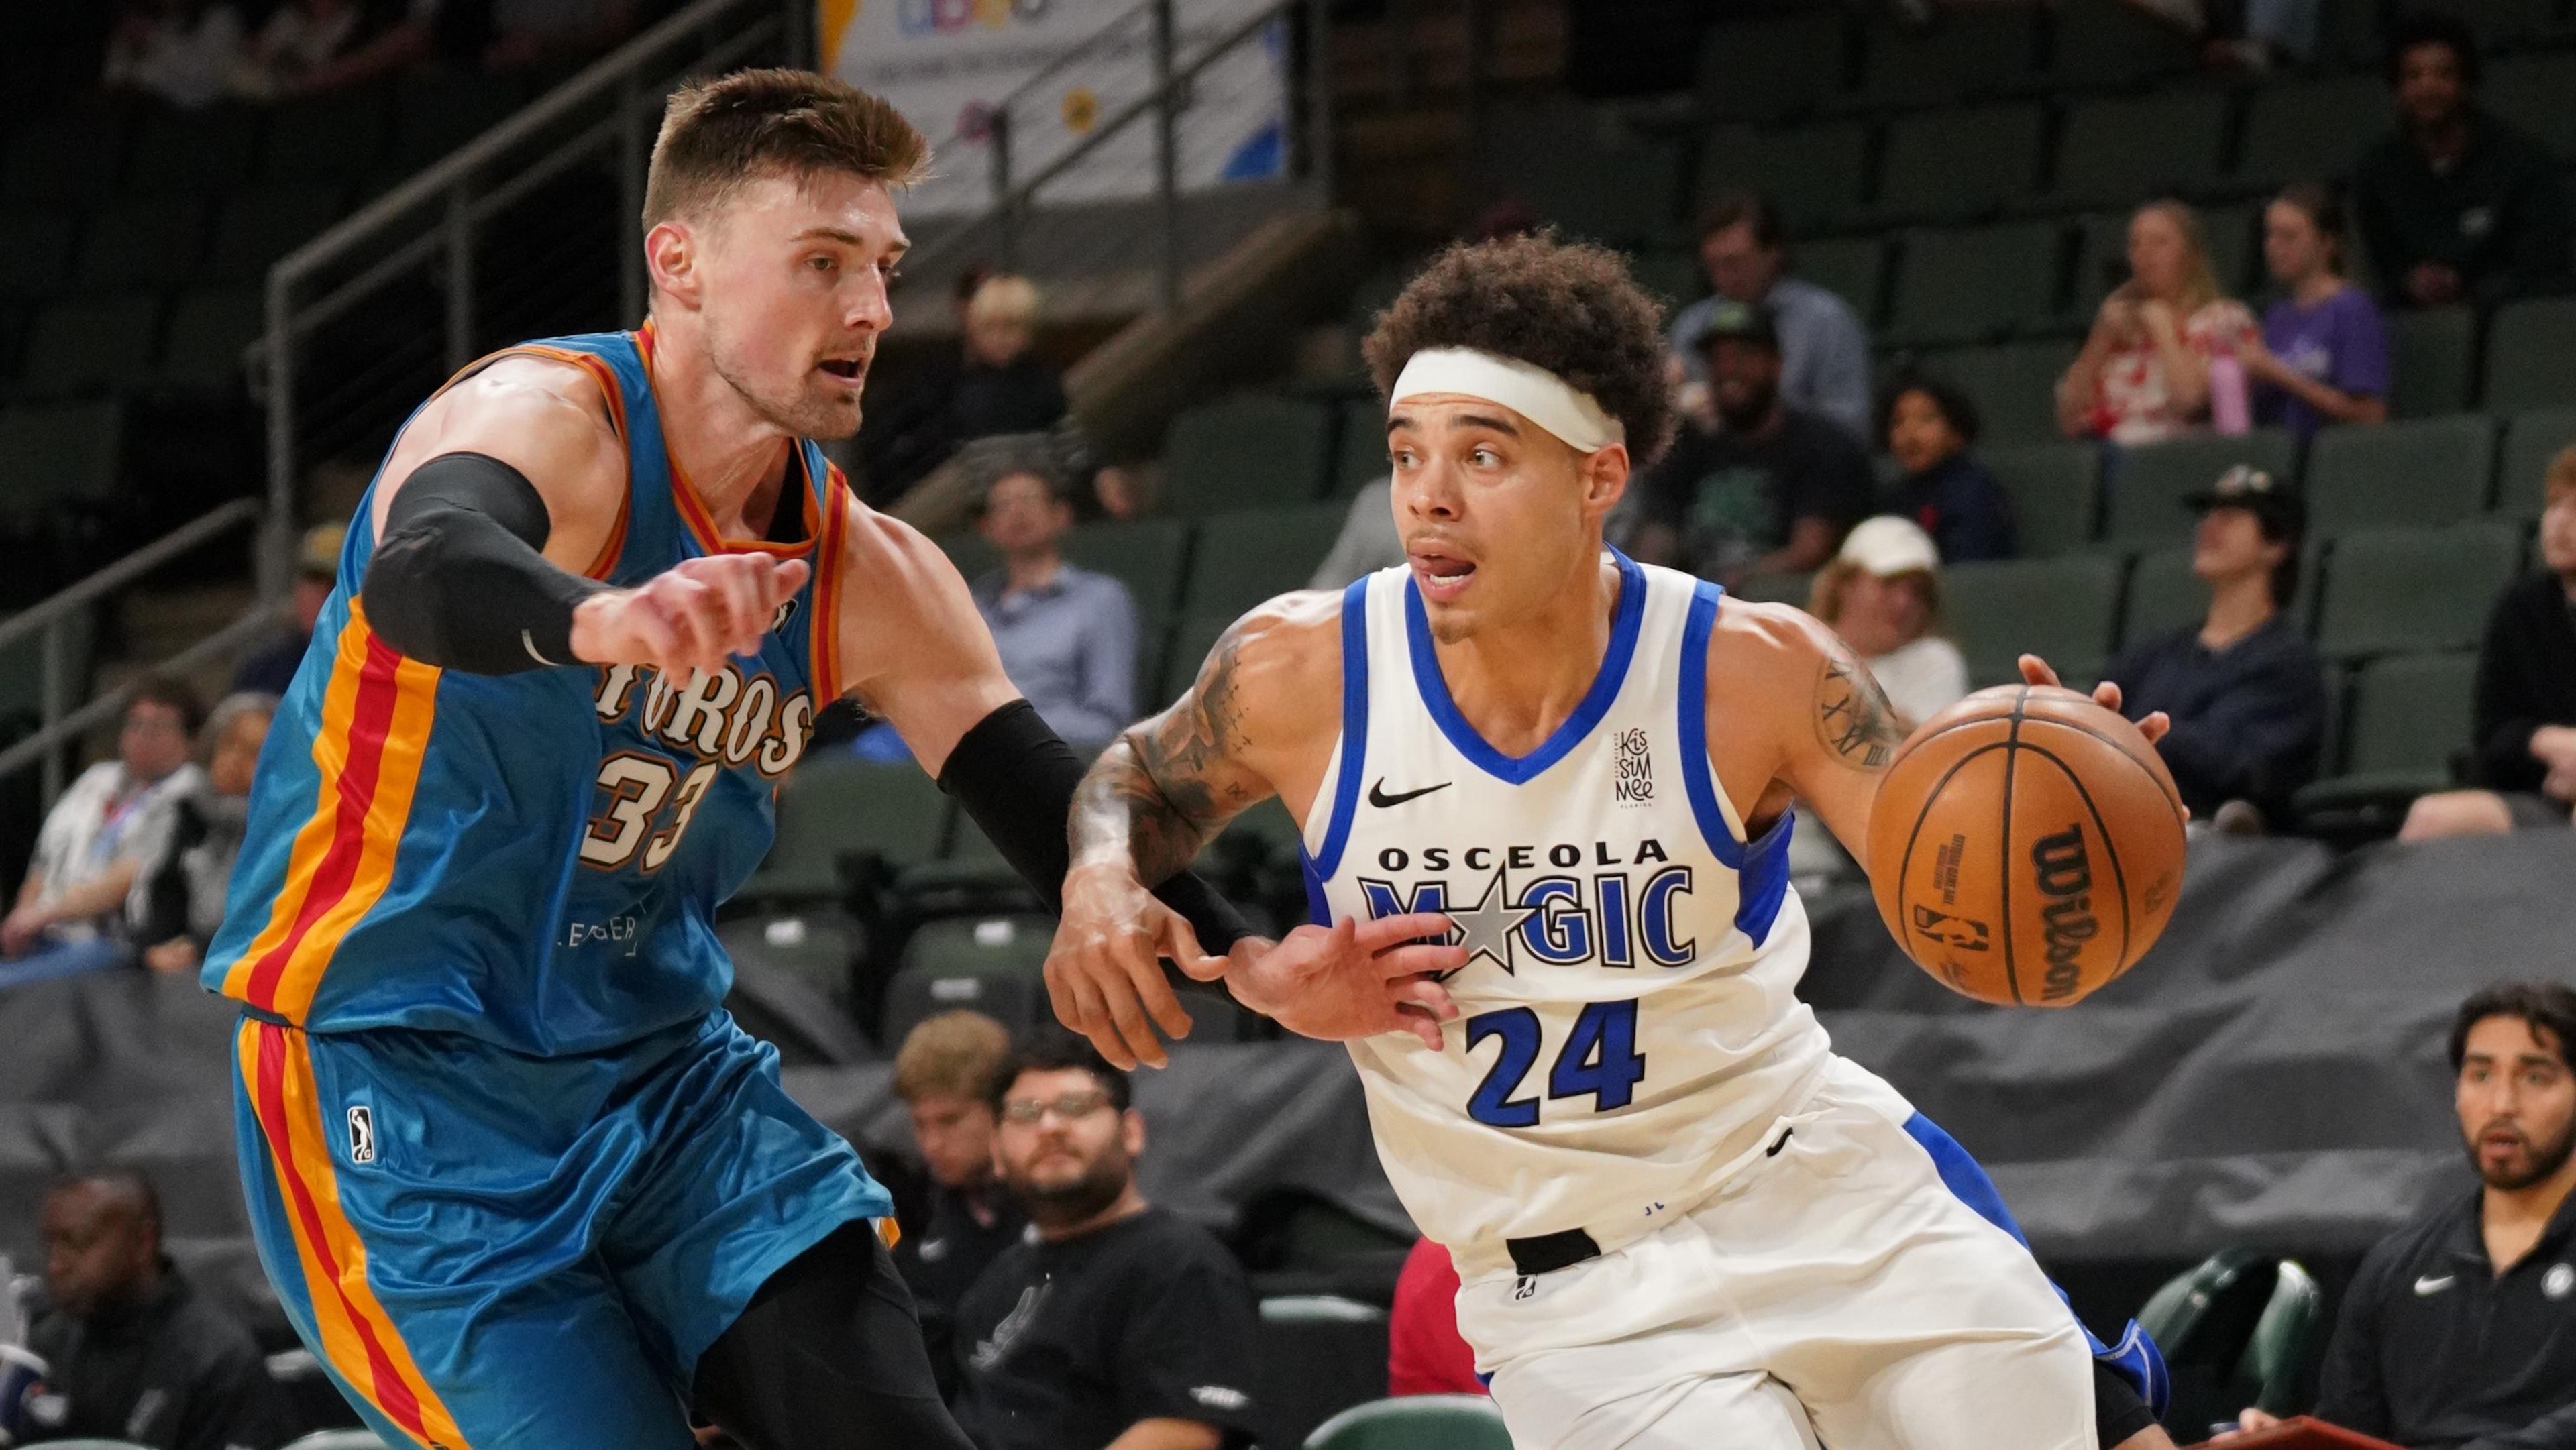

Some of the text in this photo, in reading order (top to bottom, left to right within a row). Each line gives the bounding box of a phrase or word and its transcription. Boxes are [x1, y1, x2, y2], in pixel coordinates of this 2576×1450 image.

[578, 750, 722, 873] 33
[1378, 838, 1669, 871] OSCEOLA
[2031, 822, 2101, 1000] Wilson
[1465, 997, 1646, 1128] 24
